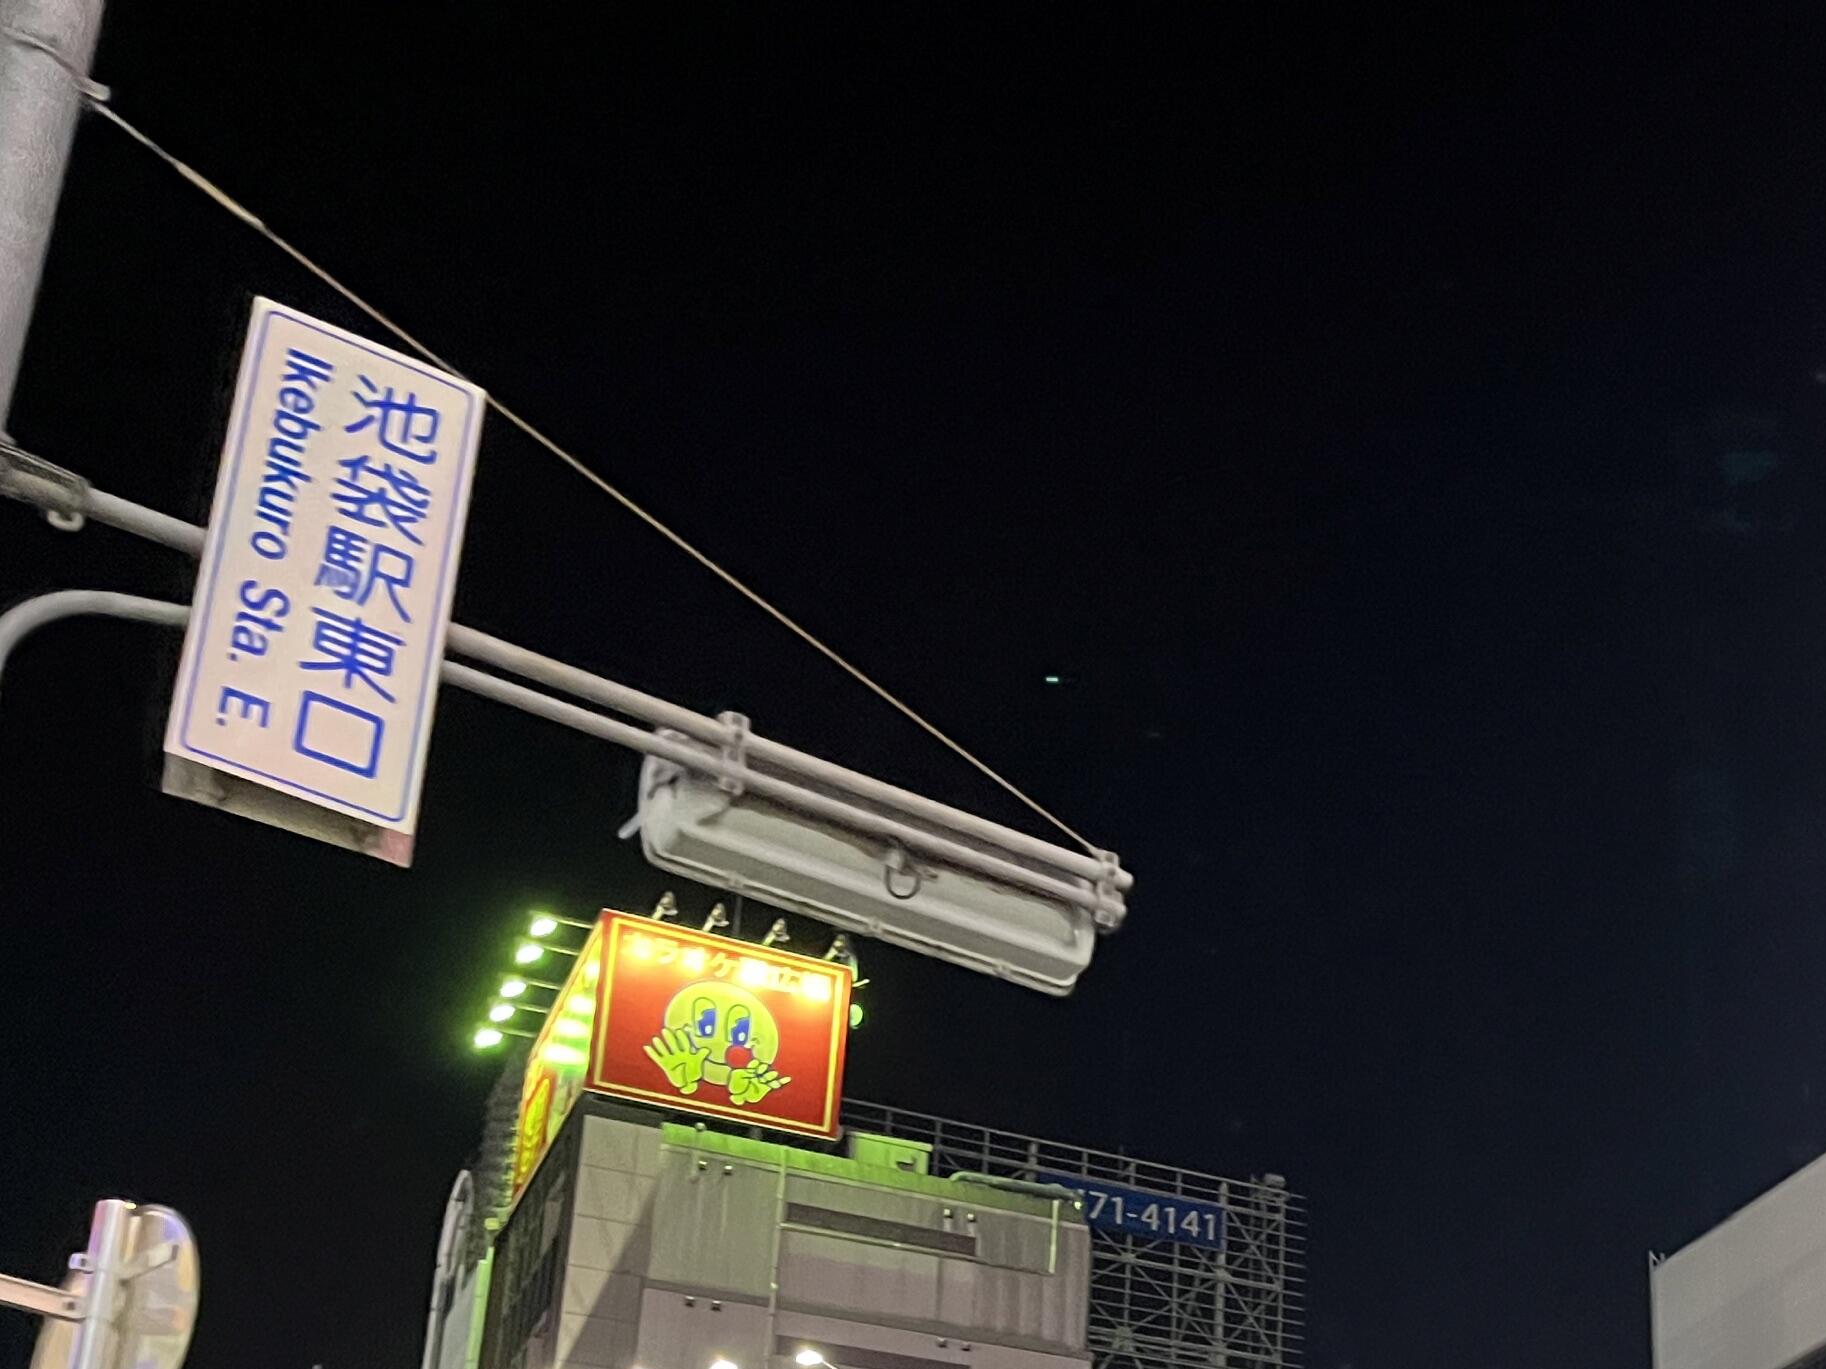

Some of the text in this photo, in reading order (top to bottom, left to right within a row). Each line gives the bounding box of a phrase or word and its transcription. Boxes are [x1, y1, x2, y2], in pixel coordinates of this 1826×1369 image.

[214, 347, 334, 729] Ikebukuro Sta. E.
[294, 373, 441, 780] 池袋駅東口
[1078, 1189, 1217, 1241] 71-4141
